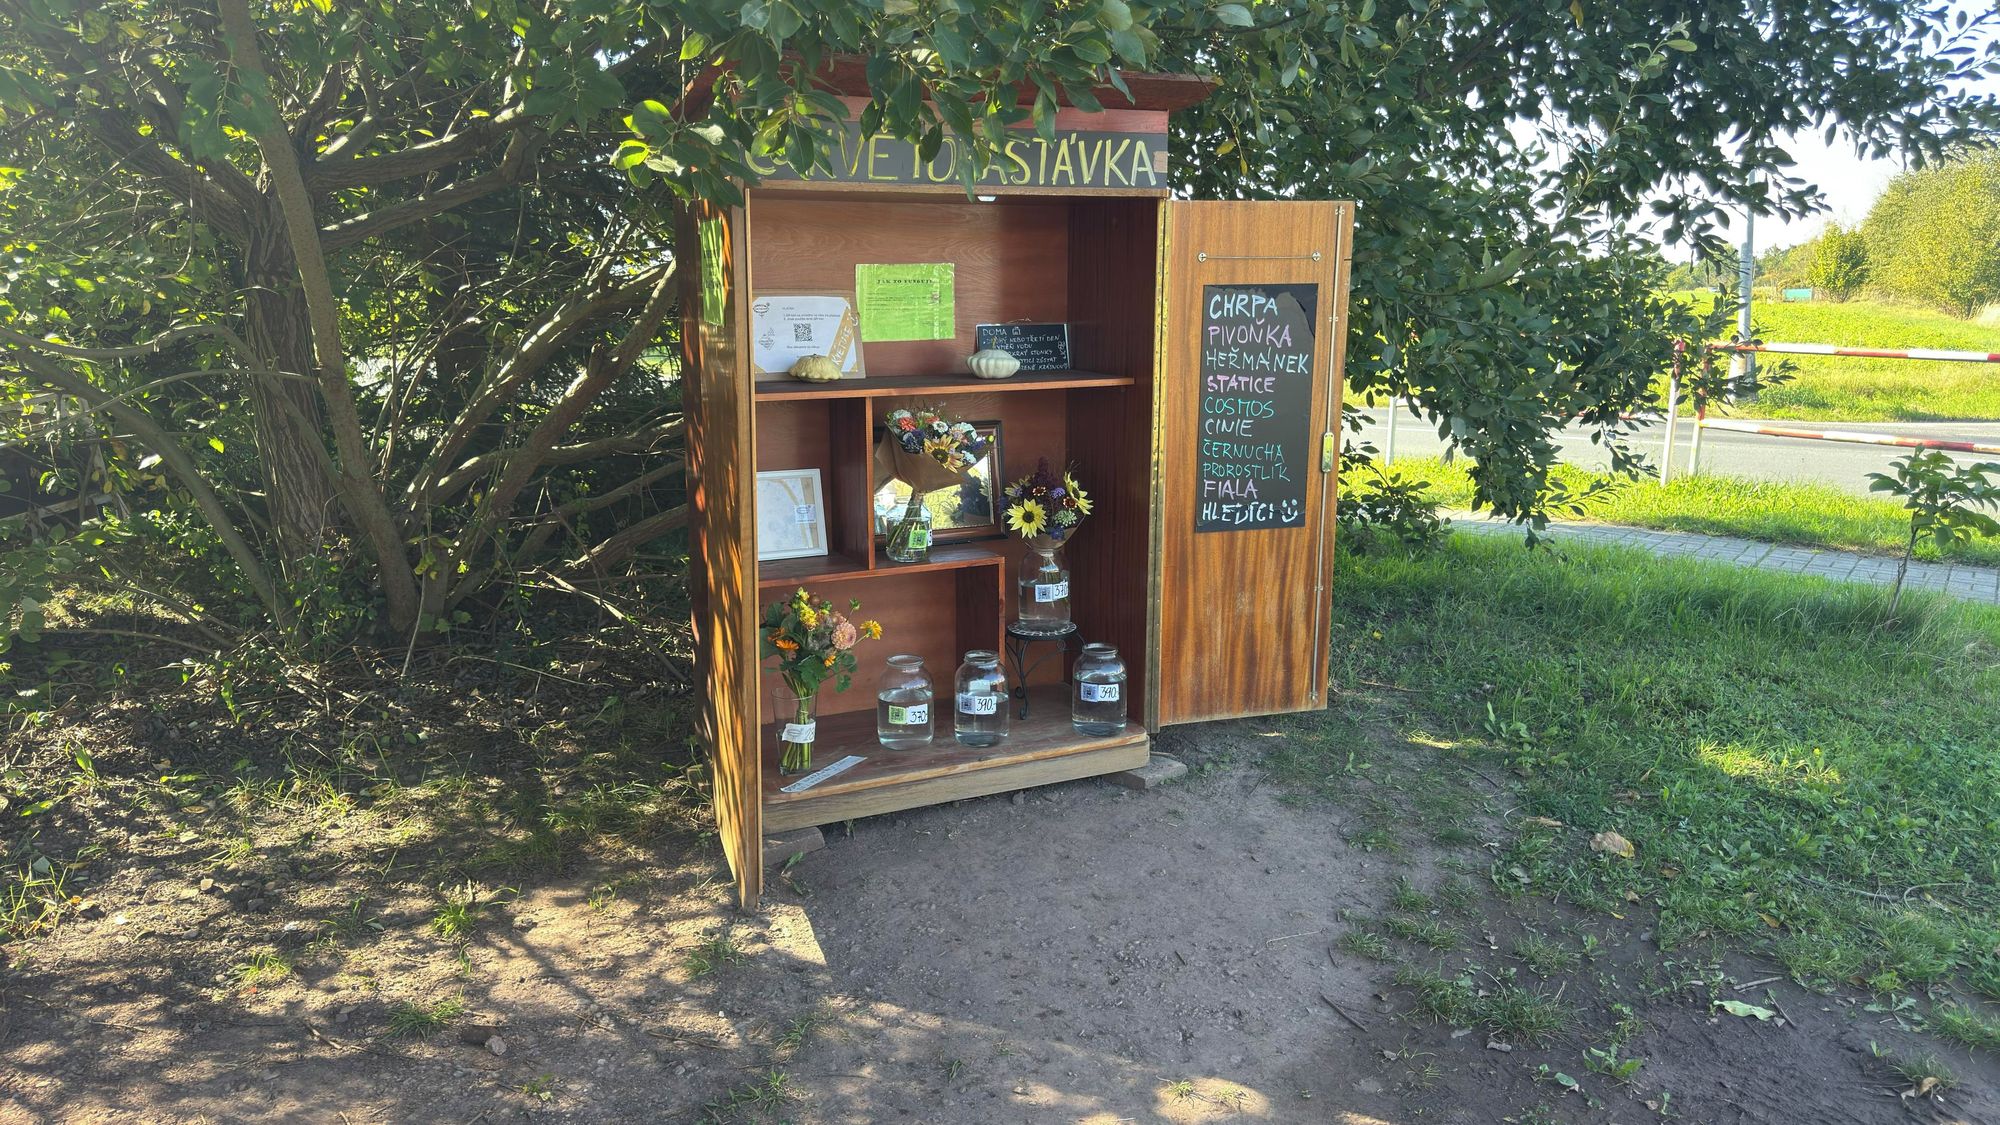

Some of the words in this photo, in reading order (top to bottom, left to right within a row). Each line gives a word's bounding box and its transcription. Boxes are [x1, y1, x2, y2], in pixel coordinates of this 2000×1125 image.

[1209, 293, 1278, 319] CHRPA
[982, 328, 1008, 336] DOMA
[1208, 318, 1292, 348] PIVOŇKA
[1206, 346, 1309, 374] HEŘMÁNEK
[1207, 374, 1276, 394] STATICE
[1204, 397, 1275, 418] COSMOS
[1205, 418, 1254, 437] CINIE
[1203, 438, 1285, 463] ČERNUCHA
[1203, 462, 1291, 482] PROROSTLÍK
[1204, 478, 1259, 500] FIALA
